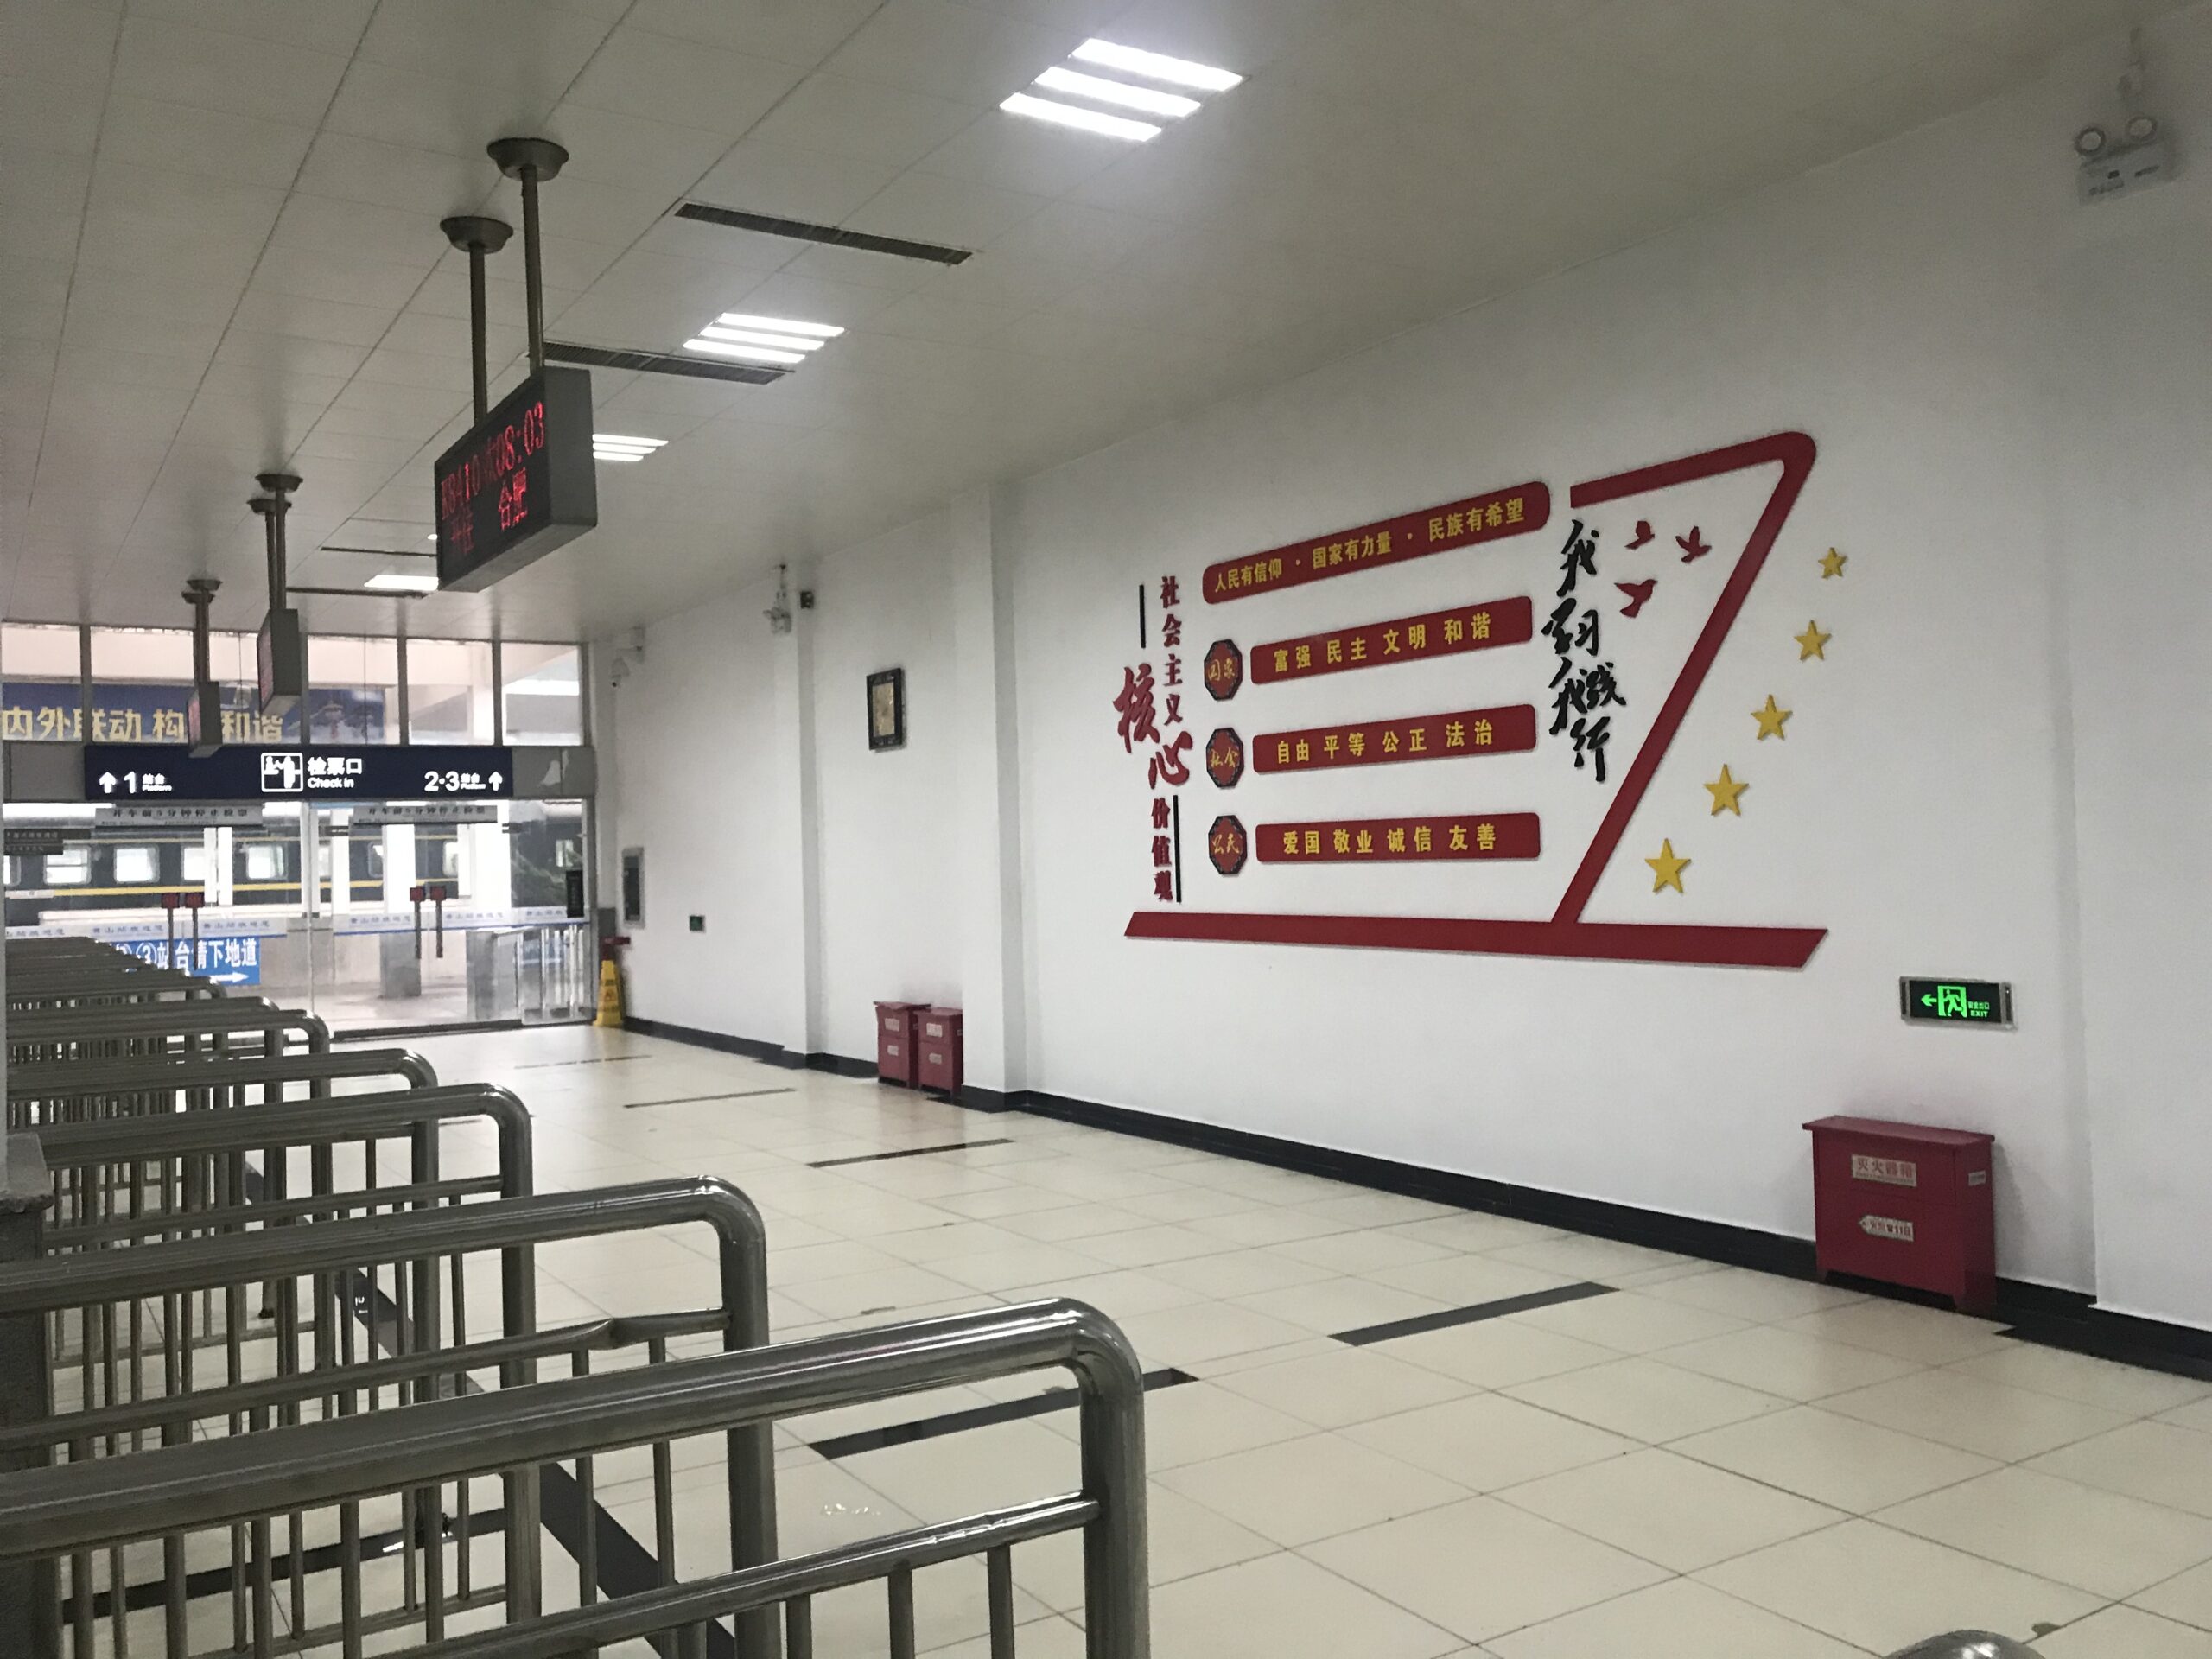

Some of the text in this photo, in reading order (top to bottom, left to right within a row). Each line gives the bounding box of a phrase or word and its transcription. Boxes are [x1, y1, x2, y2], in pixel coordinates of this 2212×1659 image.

[1214, 497, 1525, 593] 人民有信仰 国家有力量 民族有希望
[1160, 576, 1184, 726] 社会主义
[1274, 612, 1492, 673] 富强 民主 文明 和谐
[1, 705, 283, 743] 内外联动 构和谐
[1277, 719, 1494, 764] 自由 平等 公正 法治
[124, 771, 137, 794] 1
[307, 756, 363, 776] 检票口
[1151, 797, 1174, 902] 价值观
[1282, 822, 1497, 855] 爱国 敬业 诚信 友善
